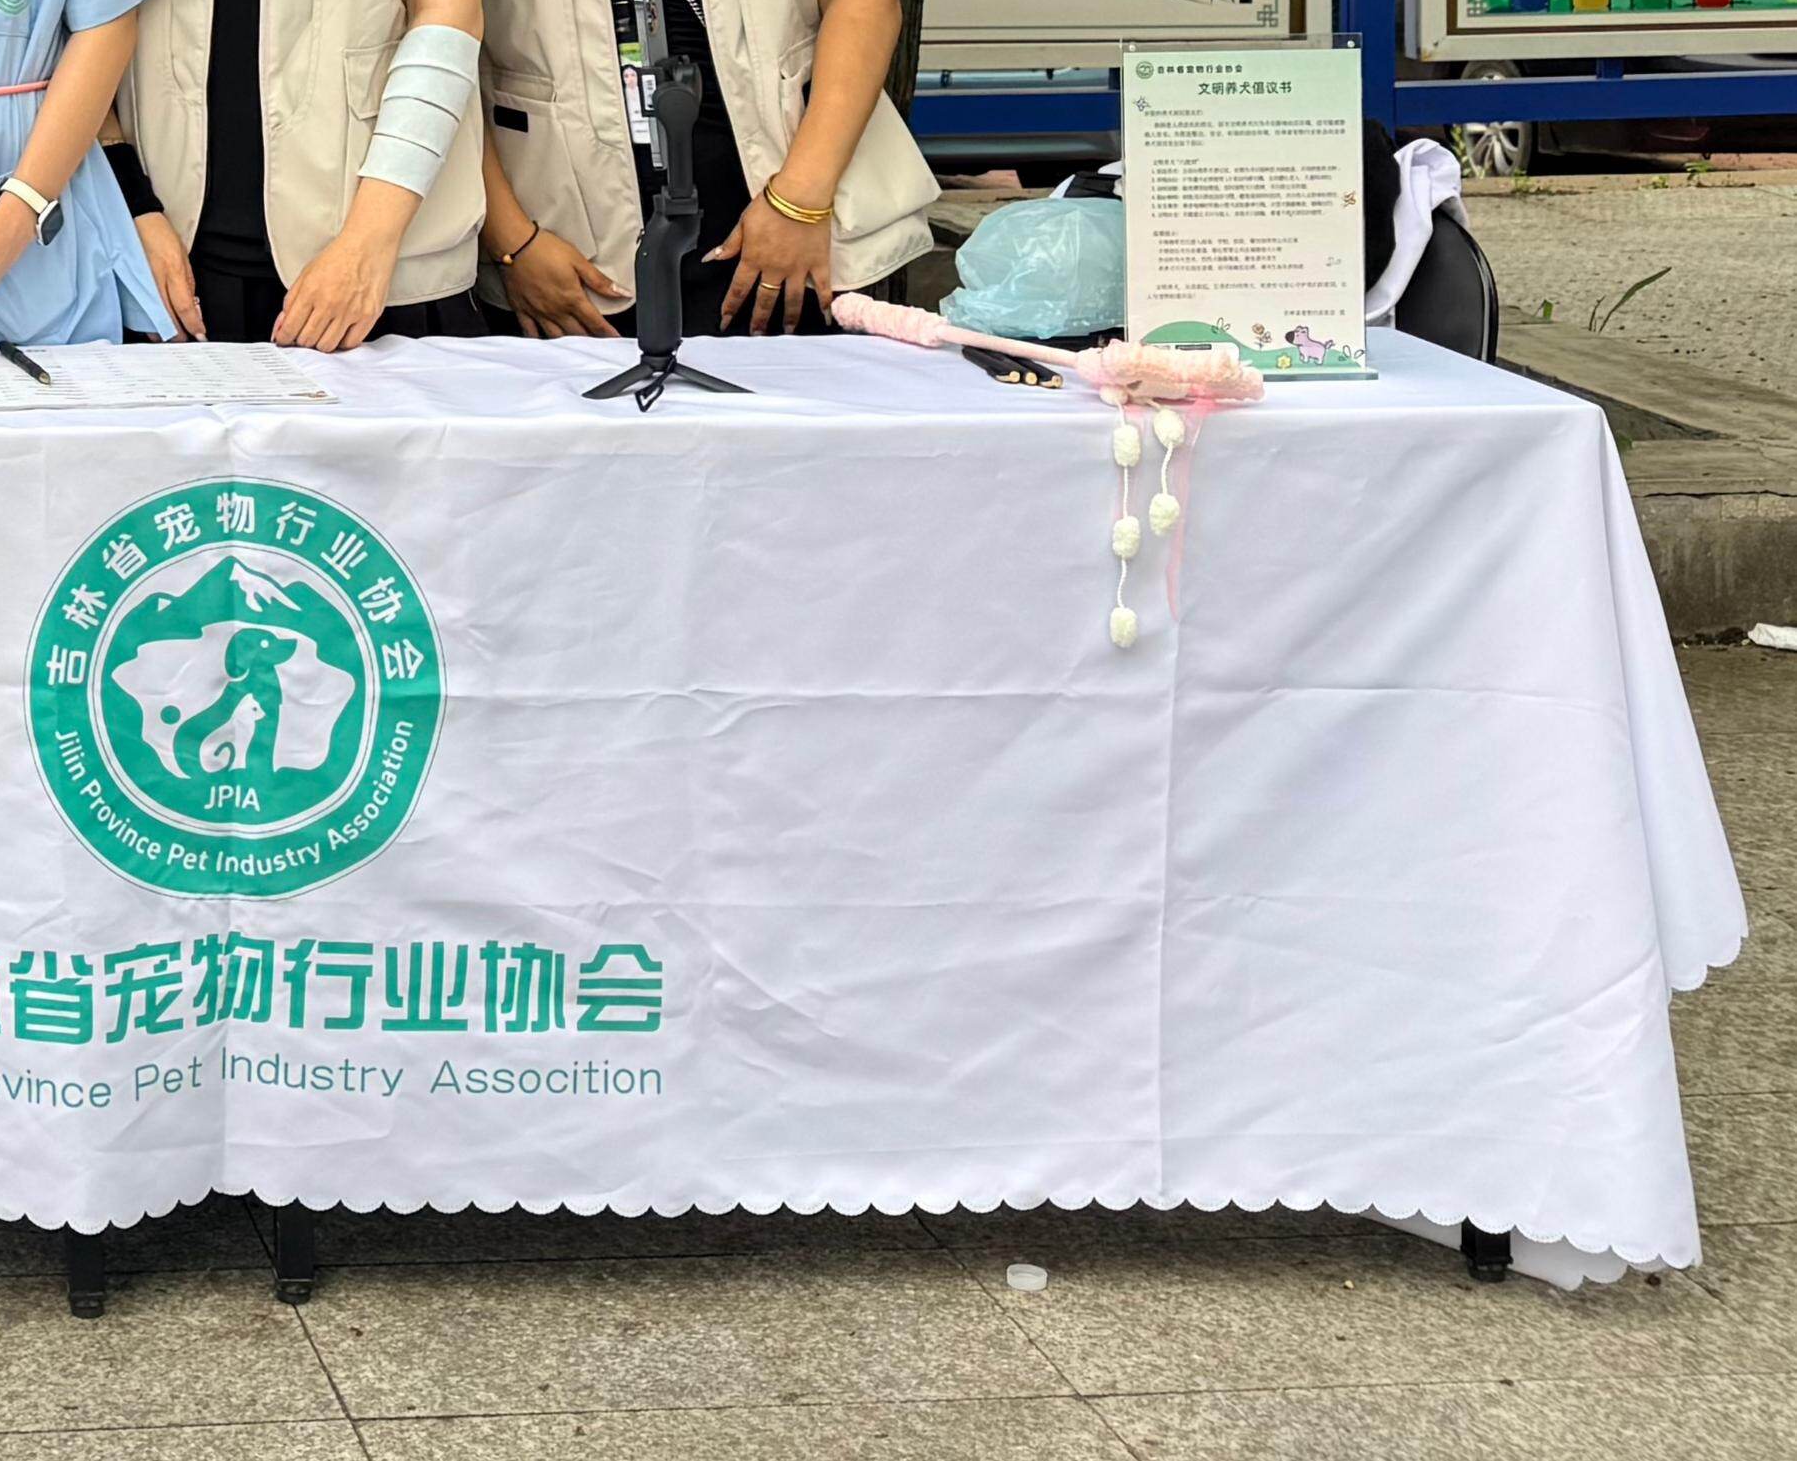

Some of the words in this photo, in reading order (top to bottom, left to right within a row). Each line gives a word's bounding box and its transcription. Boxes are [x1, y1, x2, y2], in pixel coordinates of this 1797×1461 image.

[1198, 81, 1292, 96] 文明养犬倡议书
[46, 492, 424, 686] 吉林省宠物行业协会
[55, 728, 88, 782] Jilin
[79, 778, 163, 861] Province
[166, 843, 207, 872] Pet
[216, 842, 321, 876] Industry
[327, 719, 414, 850] Association
[204, 785, 261, 812] JPIA
[134, 1056, 203, 1102] Pet
[221, 1046, 405, 1098] Industry
[429, 1058, 664, 1097] Assocition
